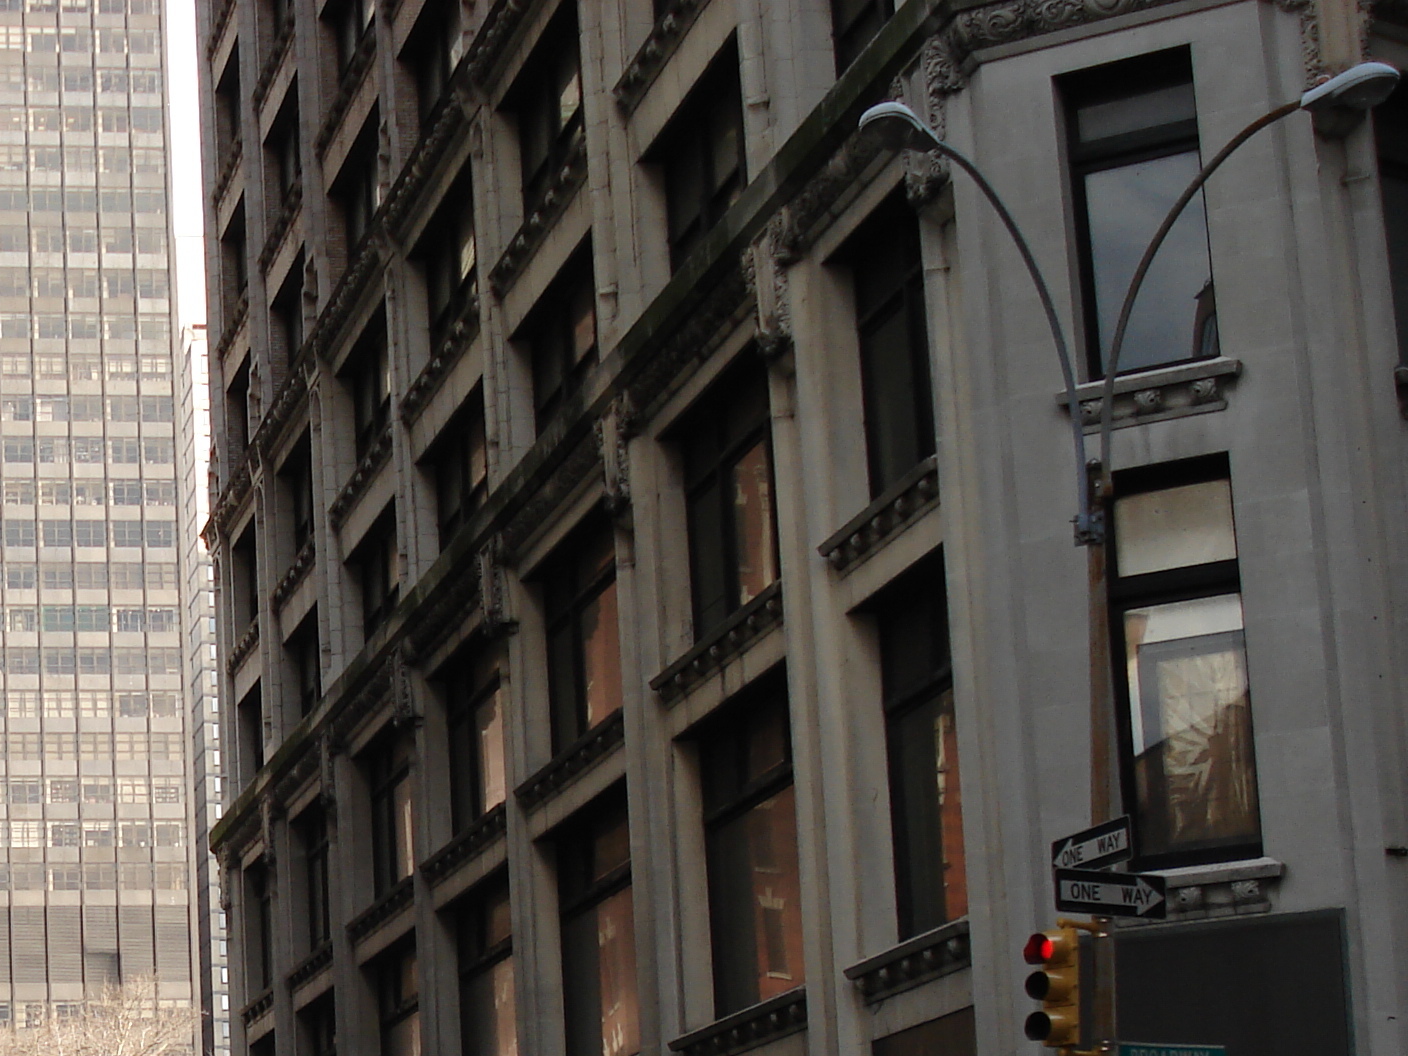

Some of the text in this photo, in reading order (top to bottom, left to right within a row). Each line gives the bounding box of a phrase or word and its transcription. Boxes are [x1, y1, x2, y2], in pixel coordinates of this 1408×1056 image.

[1062, 832, 1121, 867] ONE WAY
[1070, 883, 1153, 904] ONE WAY
